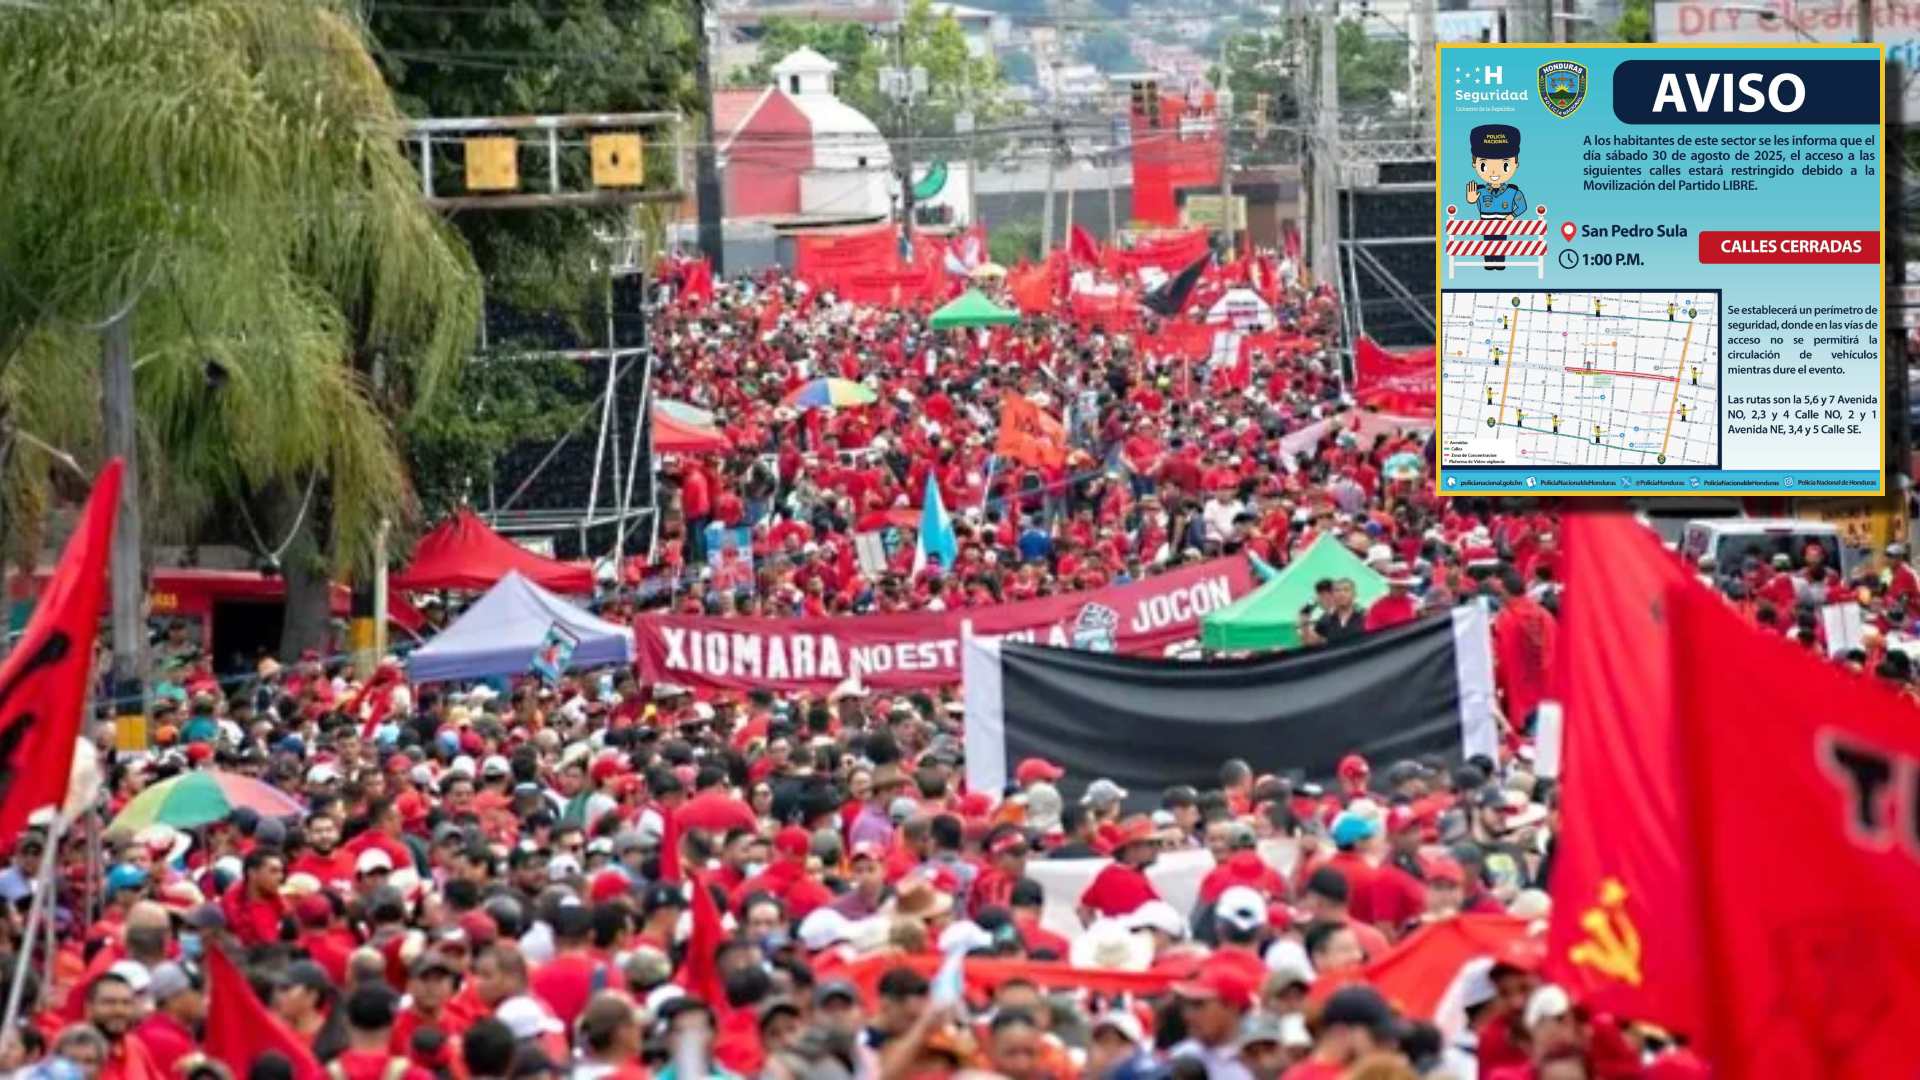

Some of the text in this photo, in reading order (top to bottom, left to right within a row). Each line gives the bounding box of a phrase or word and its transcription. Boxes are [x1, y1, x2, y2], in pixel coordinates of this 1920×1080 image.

[660, 626, 959, 678] XIOMARA NO EST
